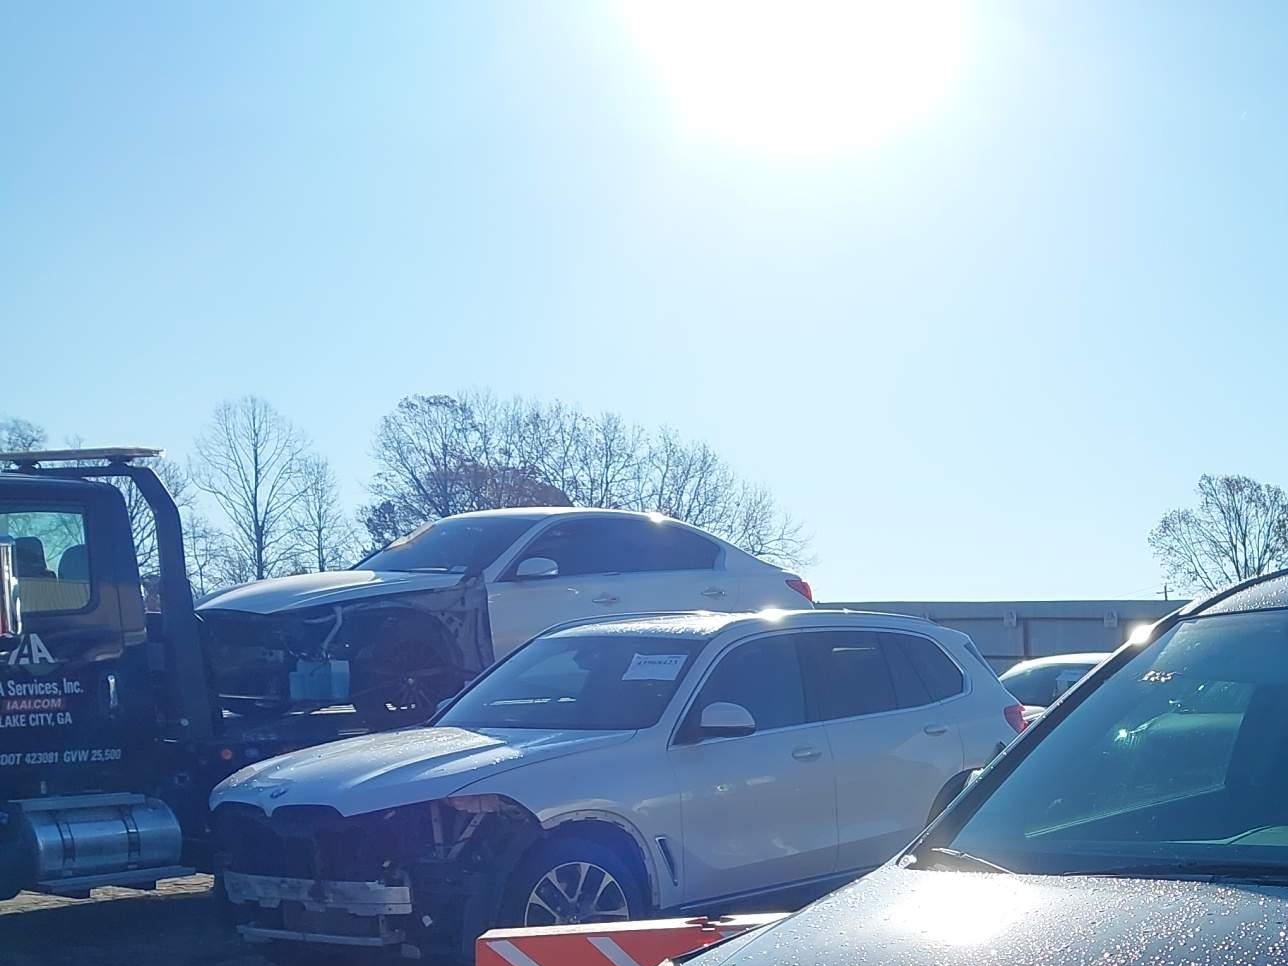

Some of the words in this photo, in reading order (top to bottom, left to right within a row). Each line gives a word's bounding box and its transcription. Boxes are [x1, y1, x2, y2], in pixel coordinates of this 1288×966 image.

[7, 679, 62, 696] Services,
[63, 677, 84, 694] Inc.
[29, 712, 55, 727] CITY,
[57, 711, 73, 725] GA
[63, 749, 89, 763] GVW
